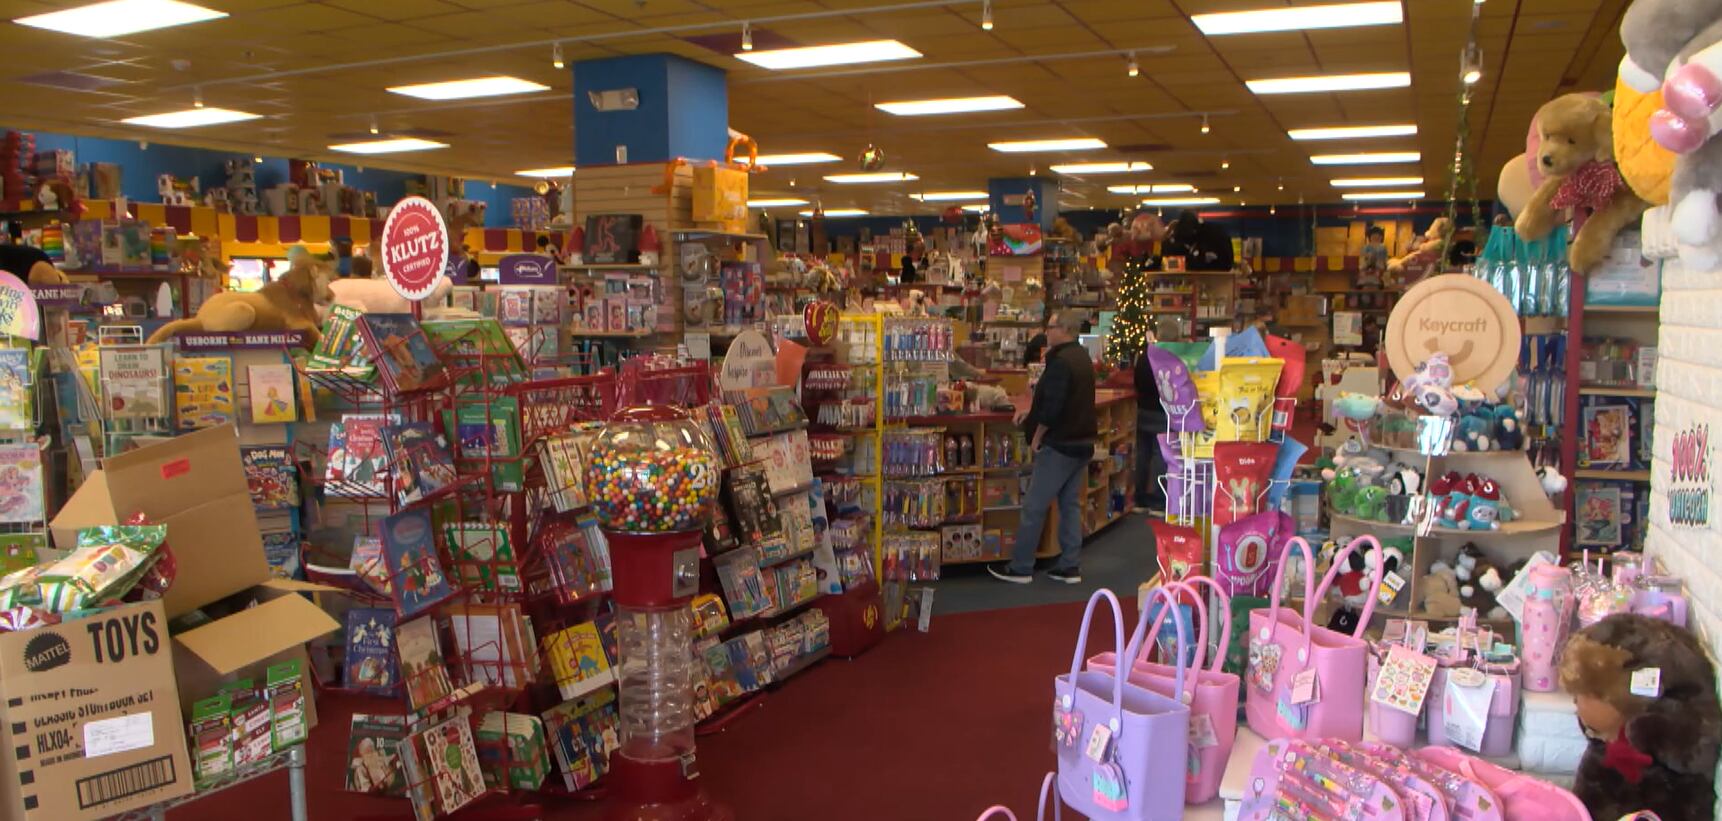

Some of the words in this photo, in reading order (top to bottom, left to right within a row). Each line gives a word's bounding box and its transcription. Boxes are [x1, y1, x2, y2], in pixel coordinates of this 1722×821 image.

[390, 231, 440, 264] KLUTZ
[402, 256, 431, 272] CERTIFIED
[1418, 317, 1487, 336] Keycraft
[245, 334, 269, 345] KANE
[250, 450, 267, 460] DOG
[1671, 423, 1709, 483] 100%
[87, 611, 160, 663] TOYS
[26, 642, 70, 669] MATTEL
[376, 737, 385, 748] 10
